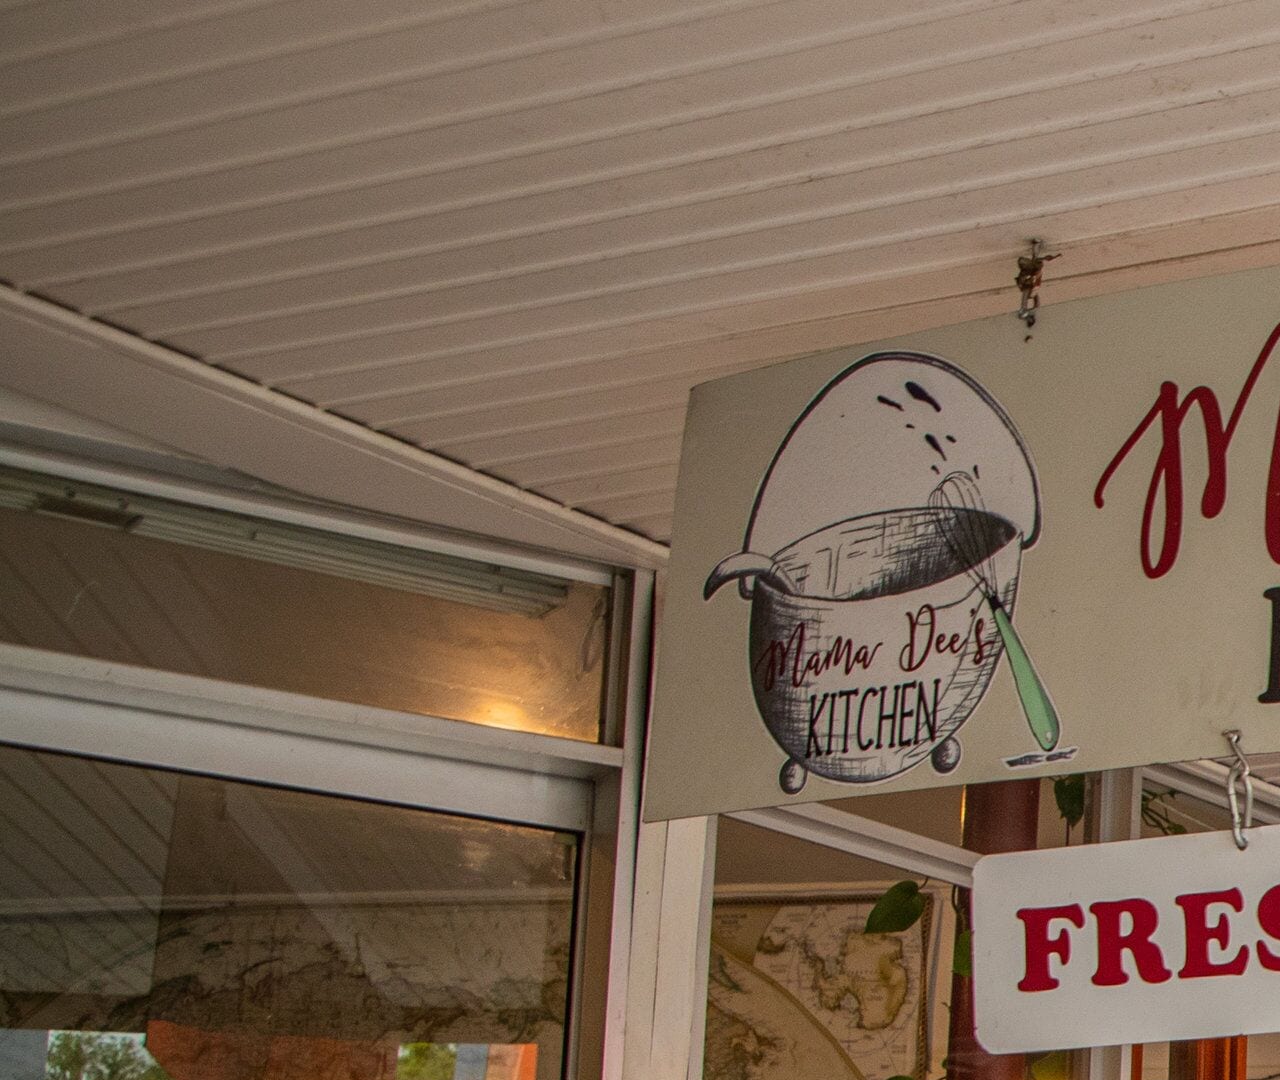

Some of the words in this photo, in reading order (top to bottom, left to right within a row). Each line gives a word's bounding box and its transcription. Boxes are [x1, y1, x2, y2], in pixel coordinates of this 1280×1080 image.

[756, 622, 883, 696] Mama
[899, 603, 997, 674] Dee's
[803, 678, 944, 760] KITCHEN
